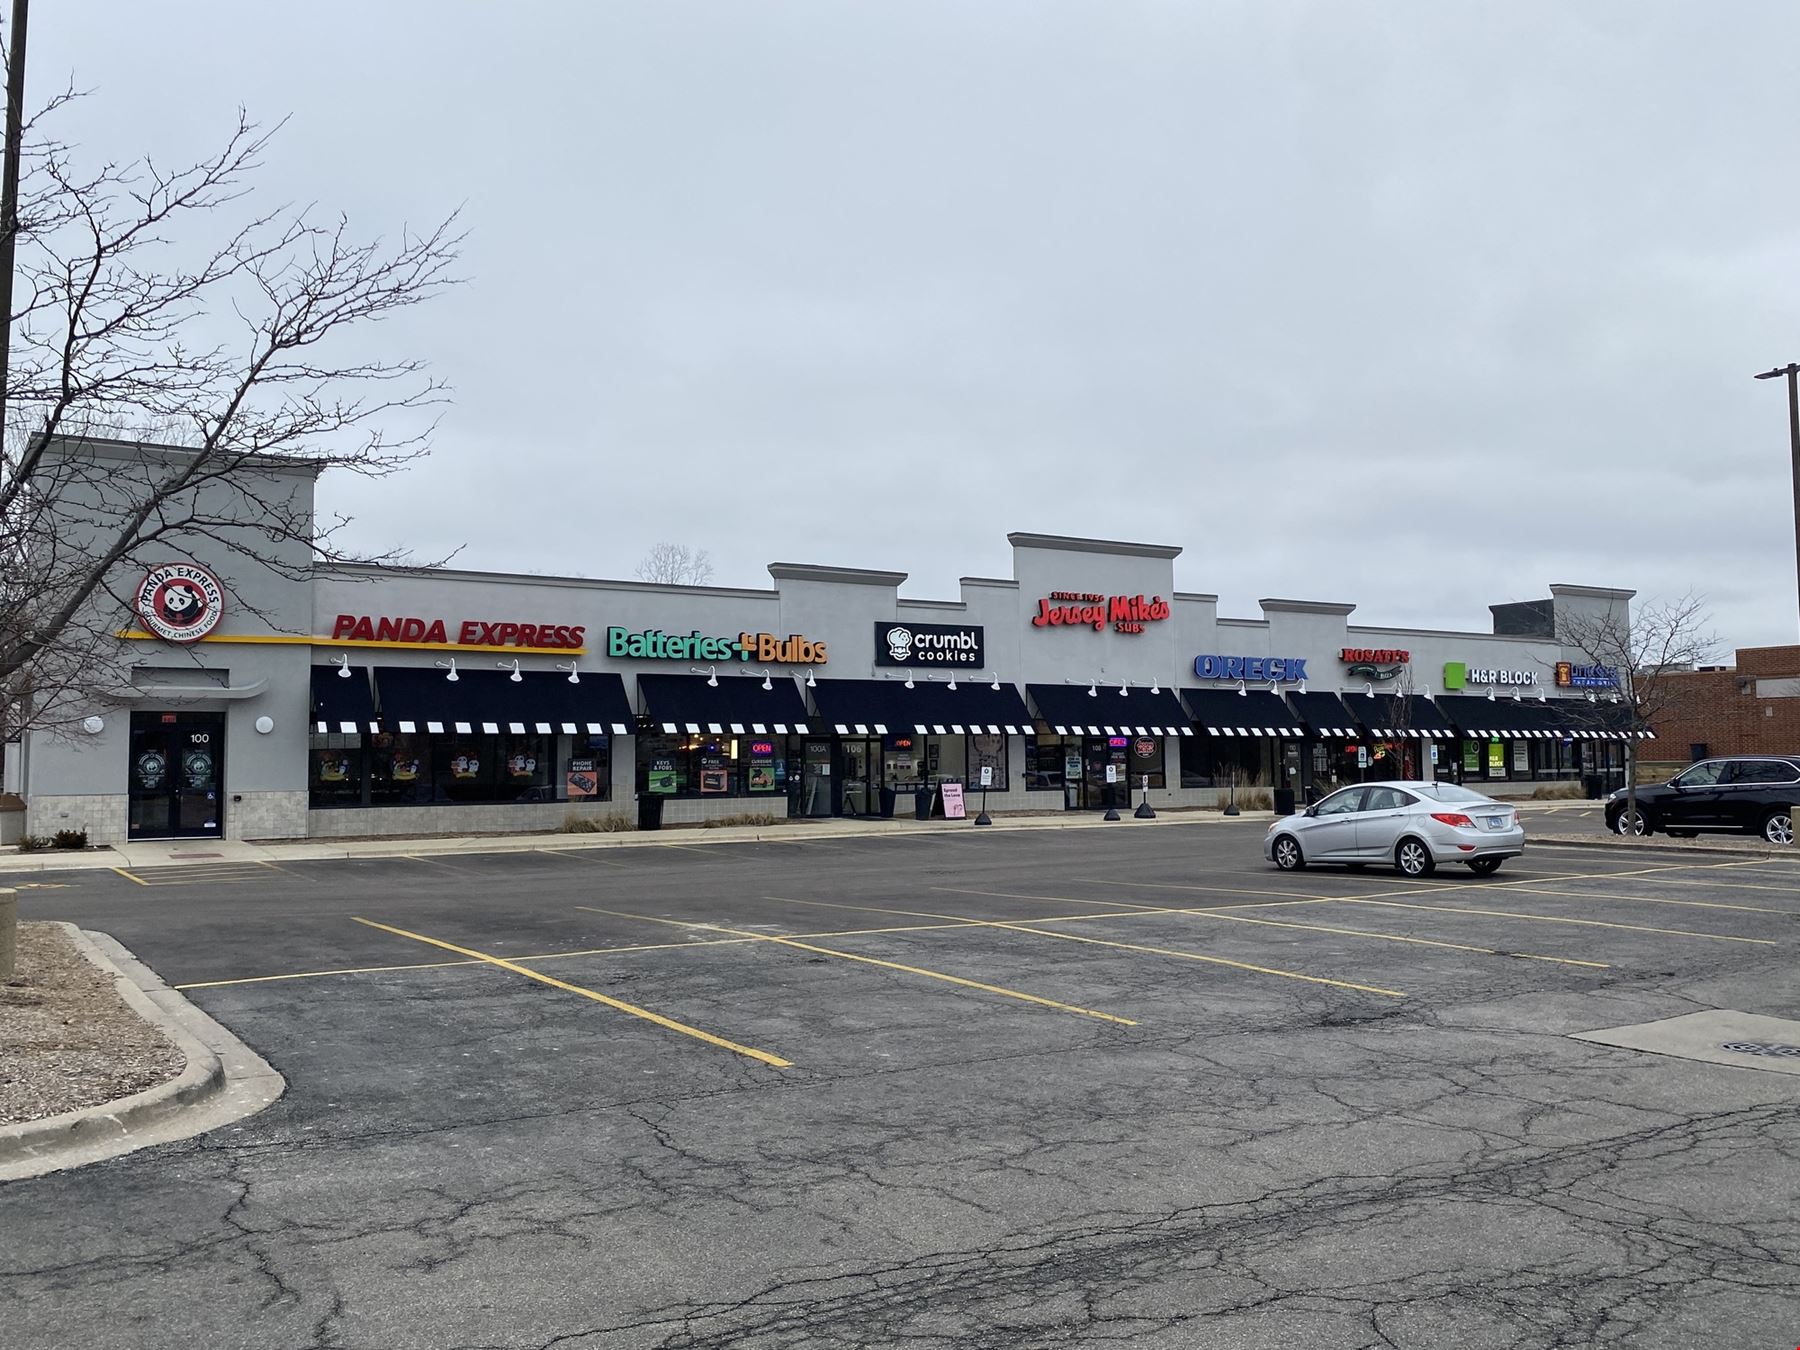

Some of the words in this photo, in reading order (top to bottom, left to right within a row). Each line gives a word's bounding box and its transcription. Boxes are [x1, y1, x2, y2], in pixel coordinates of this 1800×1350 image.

[141, 569, 174, 602] PANDA
[177, 567, 219, 603] EXPRESS
[1032, 598, 1106, 631] Jersey
[1108, 595, 1169, 622] Mike's
[173, 627, 204, 639] CHINESE
[203, 610, 218, 629] FOOD
[332, 614, 448, 643] PANDA
[457, 620, 586, 648] EXPRESS
[607, 626, 733, 661] Batteries
[756, 632, 828, 664] Bulbs
[914, 631, 979, 650] crumbl
[918, 649, 976, 662] cookies
[1195, 655, 1308, 681] ORECK
[1470, 668, 1497, 684] H&R
[1499, 670, 1539, 685] BLOCK
[190, 733, 210, 743] 100
[752, 742, 773, 753] OPEN
[895, 739, 912, 747] OPEN
